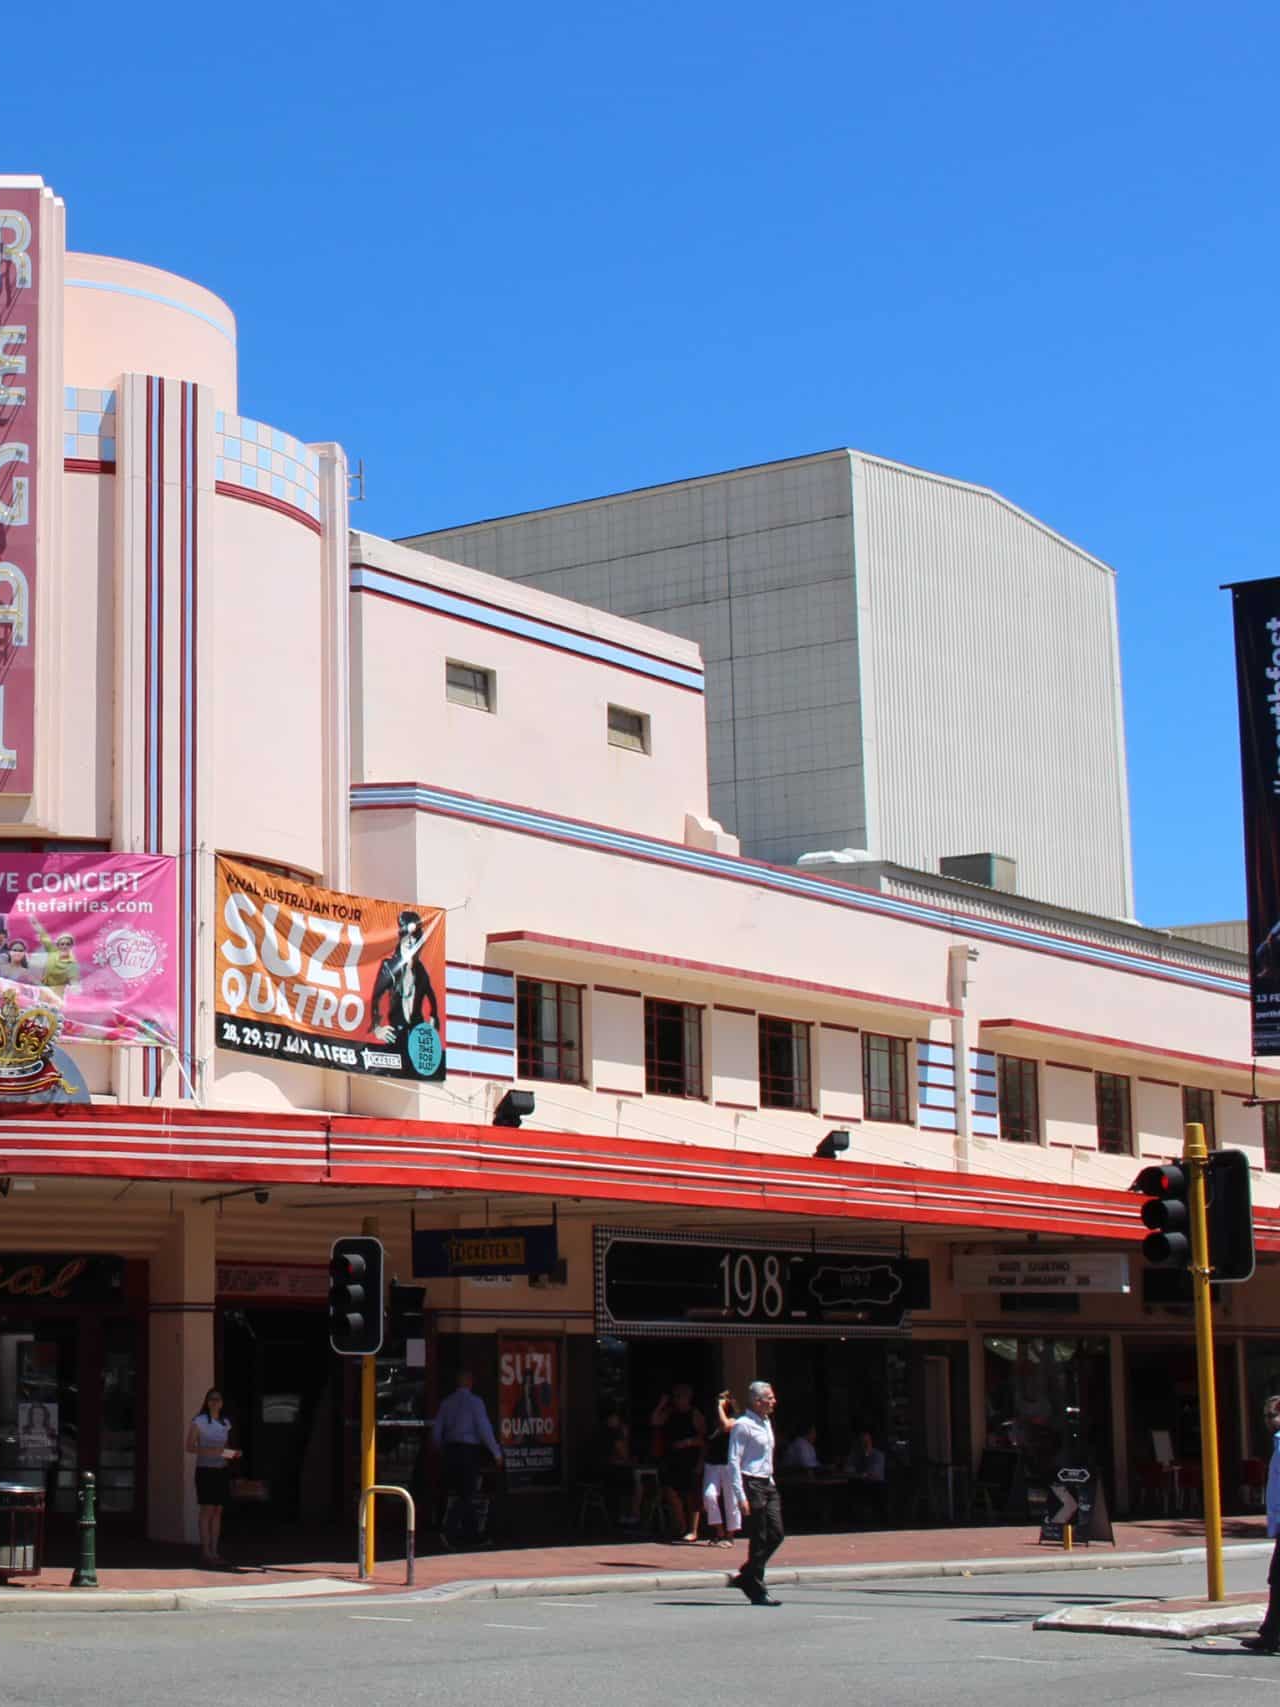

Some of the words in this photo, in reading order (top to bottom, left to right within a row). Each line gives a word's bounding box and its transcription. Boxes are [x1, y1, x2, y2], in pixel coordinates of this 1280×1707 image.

[27, 871, 144, 893] CONCERT
[16, 898, 153, 913] thefairies.com
[332, 904, 363, 922] TOUR
[221, 891, 363, 991] SUZI
[222, 968, 365, 1031] QUATRO
[222, 1022, 240, 1044] 28,
[242, 1027, 263, 1048] 29,
[282, 1033, 311, 1055] JAN
[331, 1045, 357, 1065] FEB
[720, 1252, 808, 1317] 198
[501, 1353, 552, 1385] SUZI
[501, 1417, 553, 1438] QUATRO
